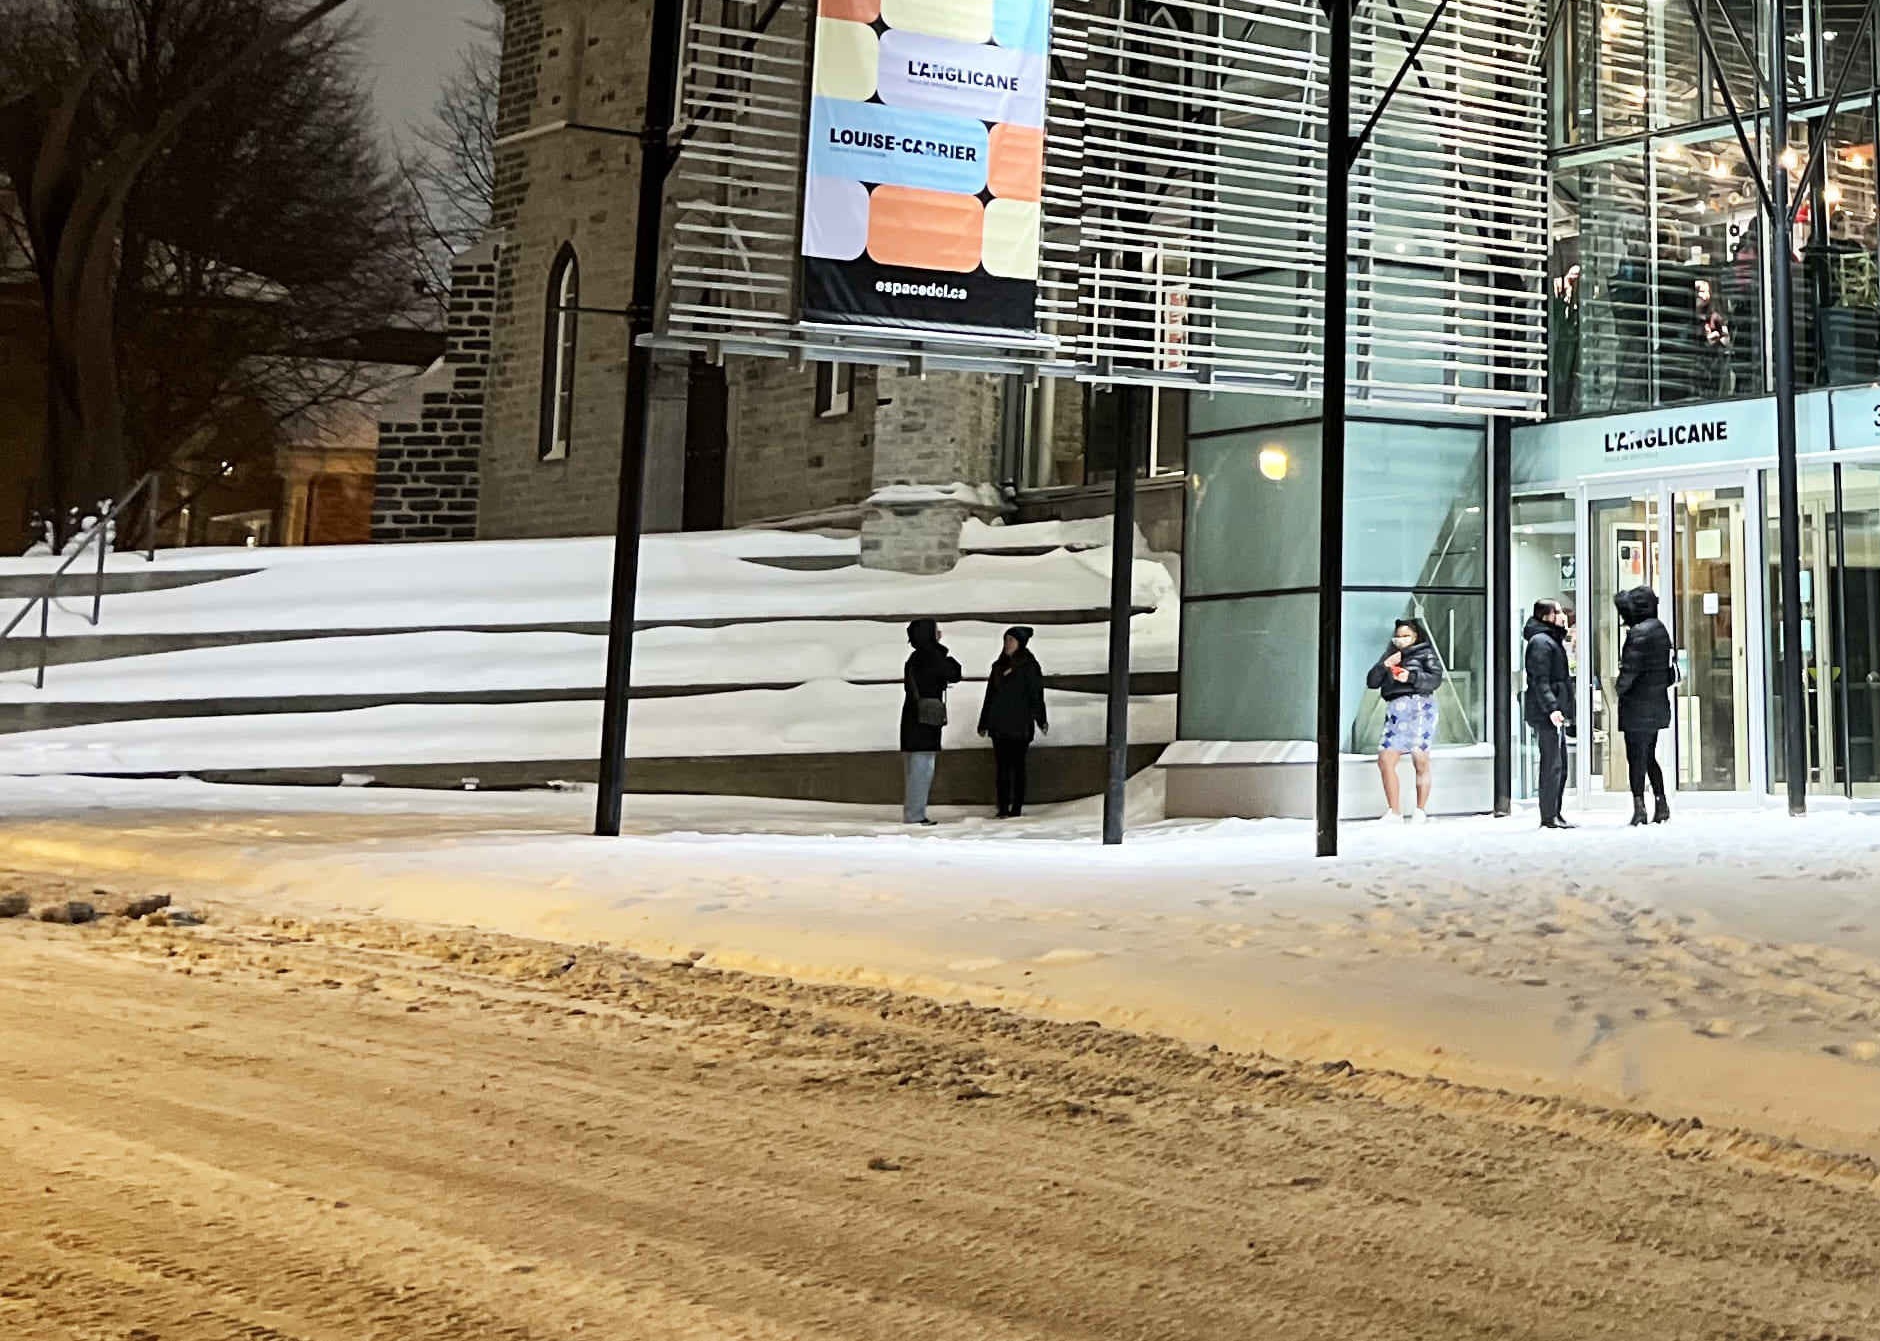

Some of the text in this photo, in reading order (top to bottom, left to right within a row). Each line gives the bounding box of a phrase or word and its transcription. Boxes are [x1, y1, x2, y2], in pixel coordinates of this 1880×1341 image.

[908, 60, 1019, 91] L'ANGLICANE
[829, 127, 977, 162] LOUISE-CARRIER
[875, 280, 968, 300] espacedcl.ca
[1605, 421, 1728, 453] L'ANGLICANE
